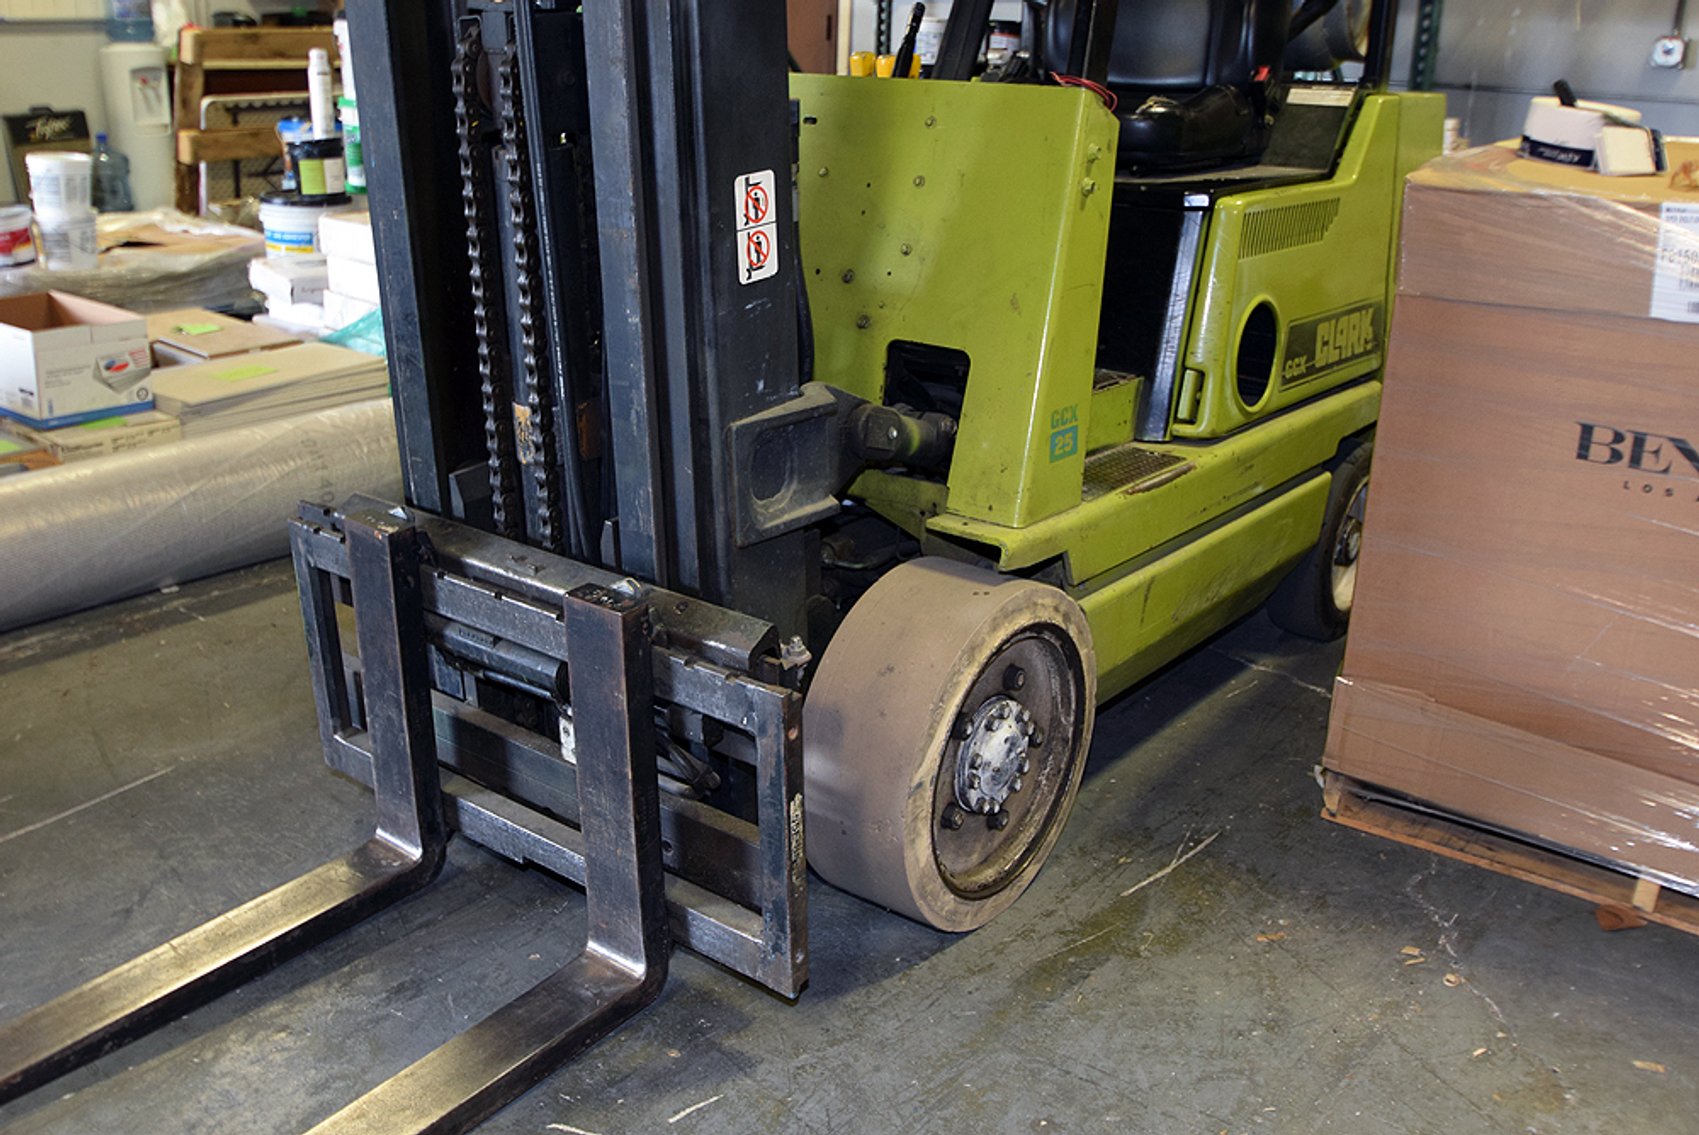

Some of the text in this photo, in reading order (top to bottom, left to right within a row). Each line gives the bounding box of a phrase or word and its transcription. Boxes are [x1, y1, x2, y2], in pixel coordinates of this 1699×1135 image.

[1315, 308, 1375, 368] CLARK
[1055, 432, 1073, 455] 25
[1622, 480, 1675, 498] LOS
